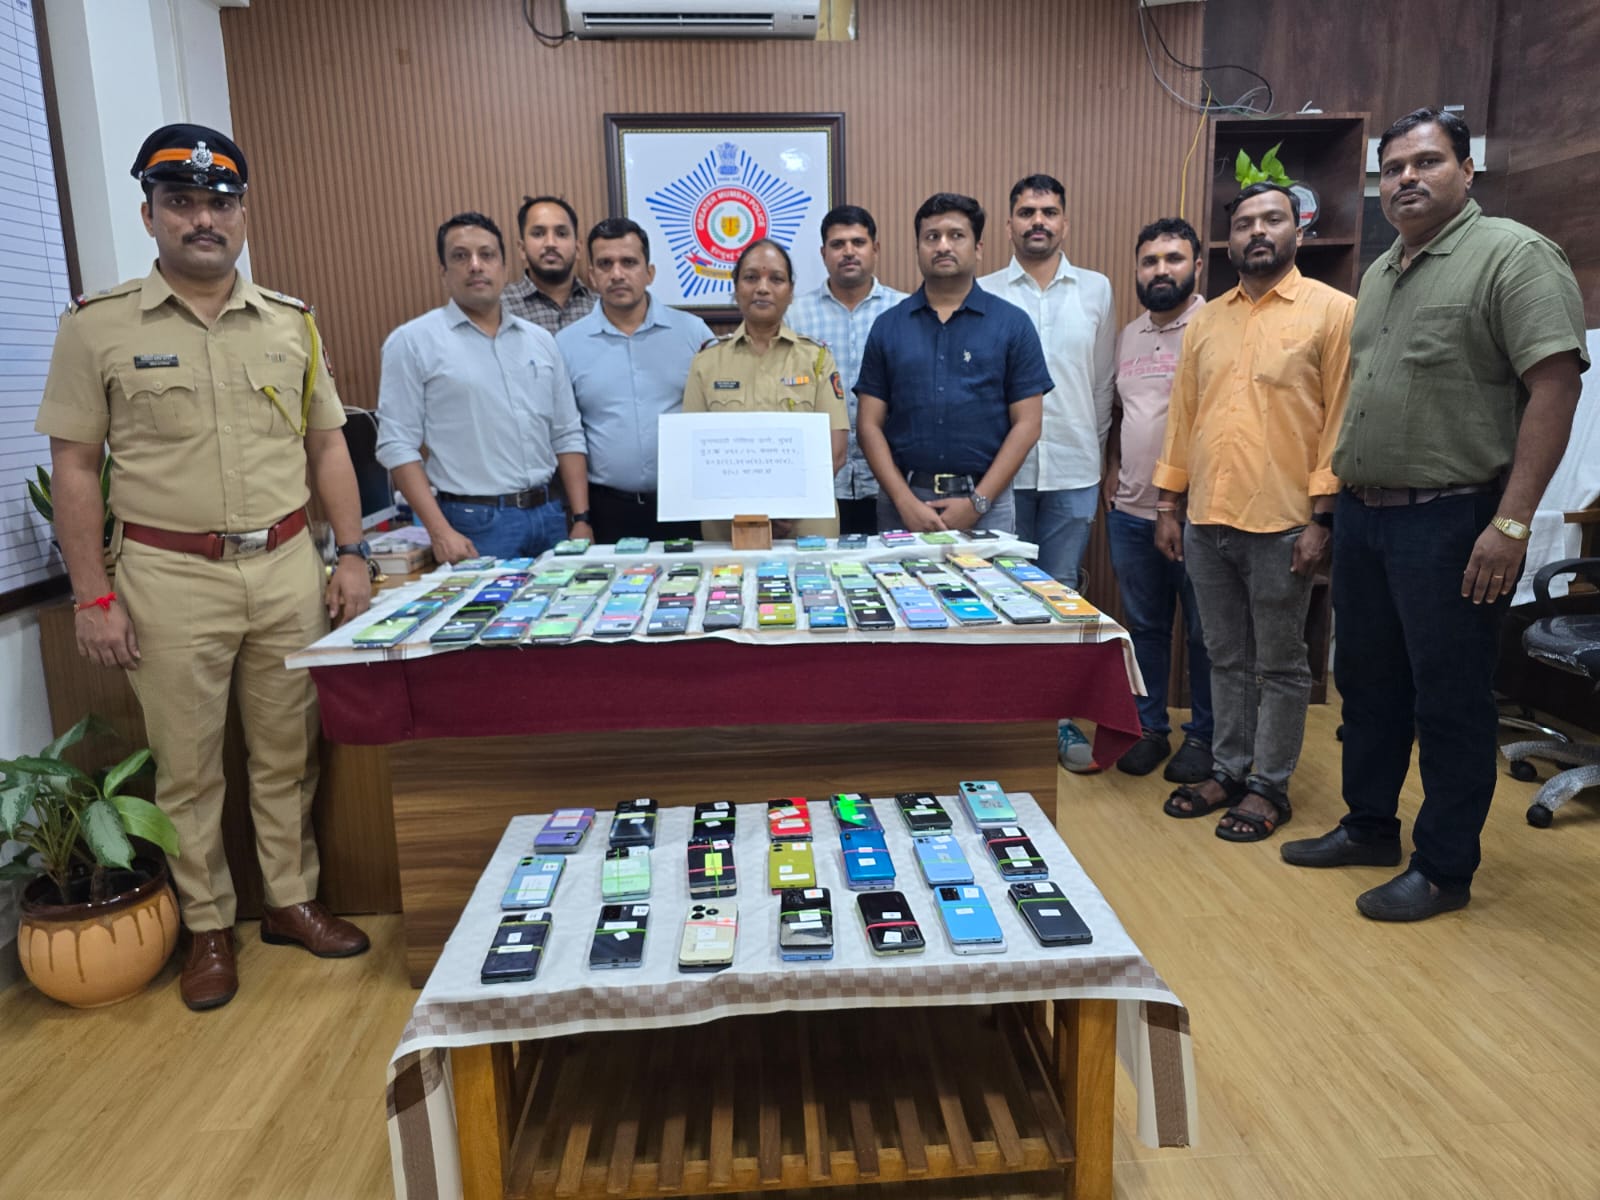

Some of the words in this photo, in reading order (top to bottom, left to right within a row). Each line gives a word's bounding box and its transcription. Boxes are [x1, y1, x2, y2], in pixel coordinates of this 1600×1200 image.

[697, 196, 717, 231] GREATER
[717, 190, 749, 202] MUMBAI
[748, 198, 765, 227] POLICE
